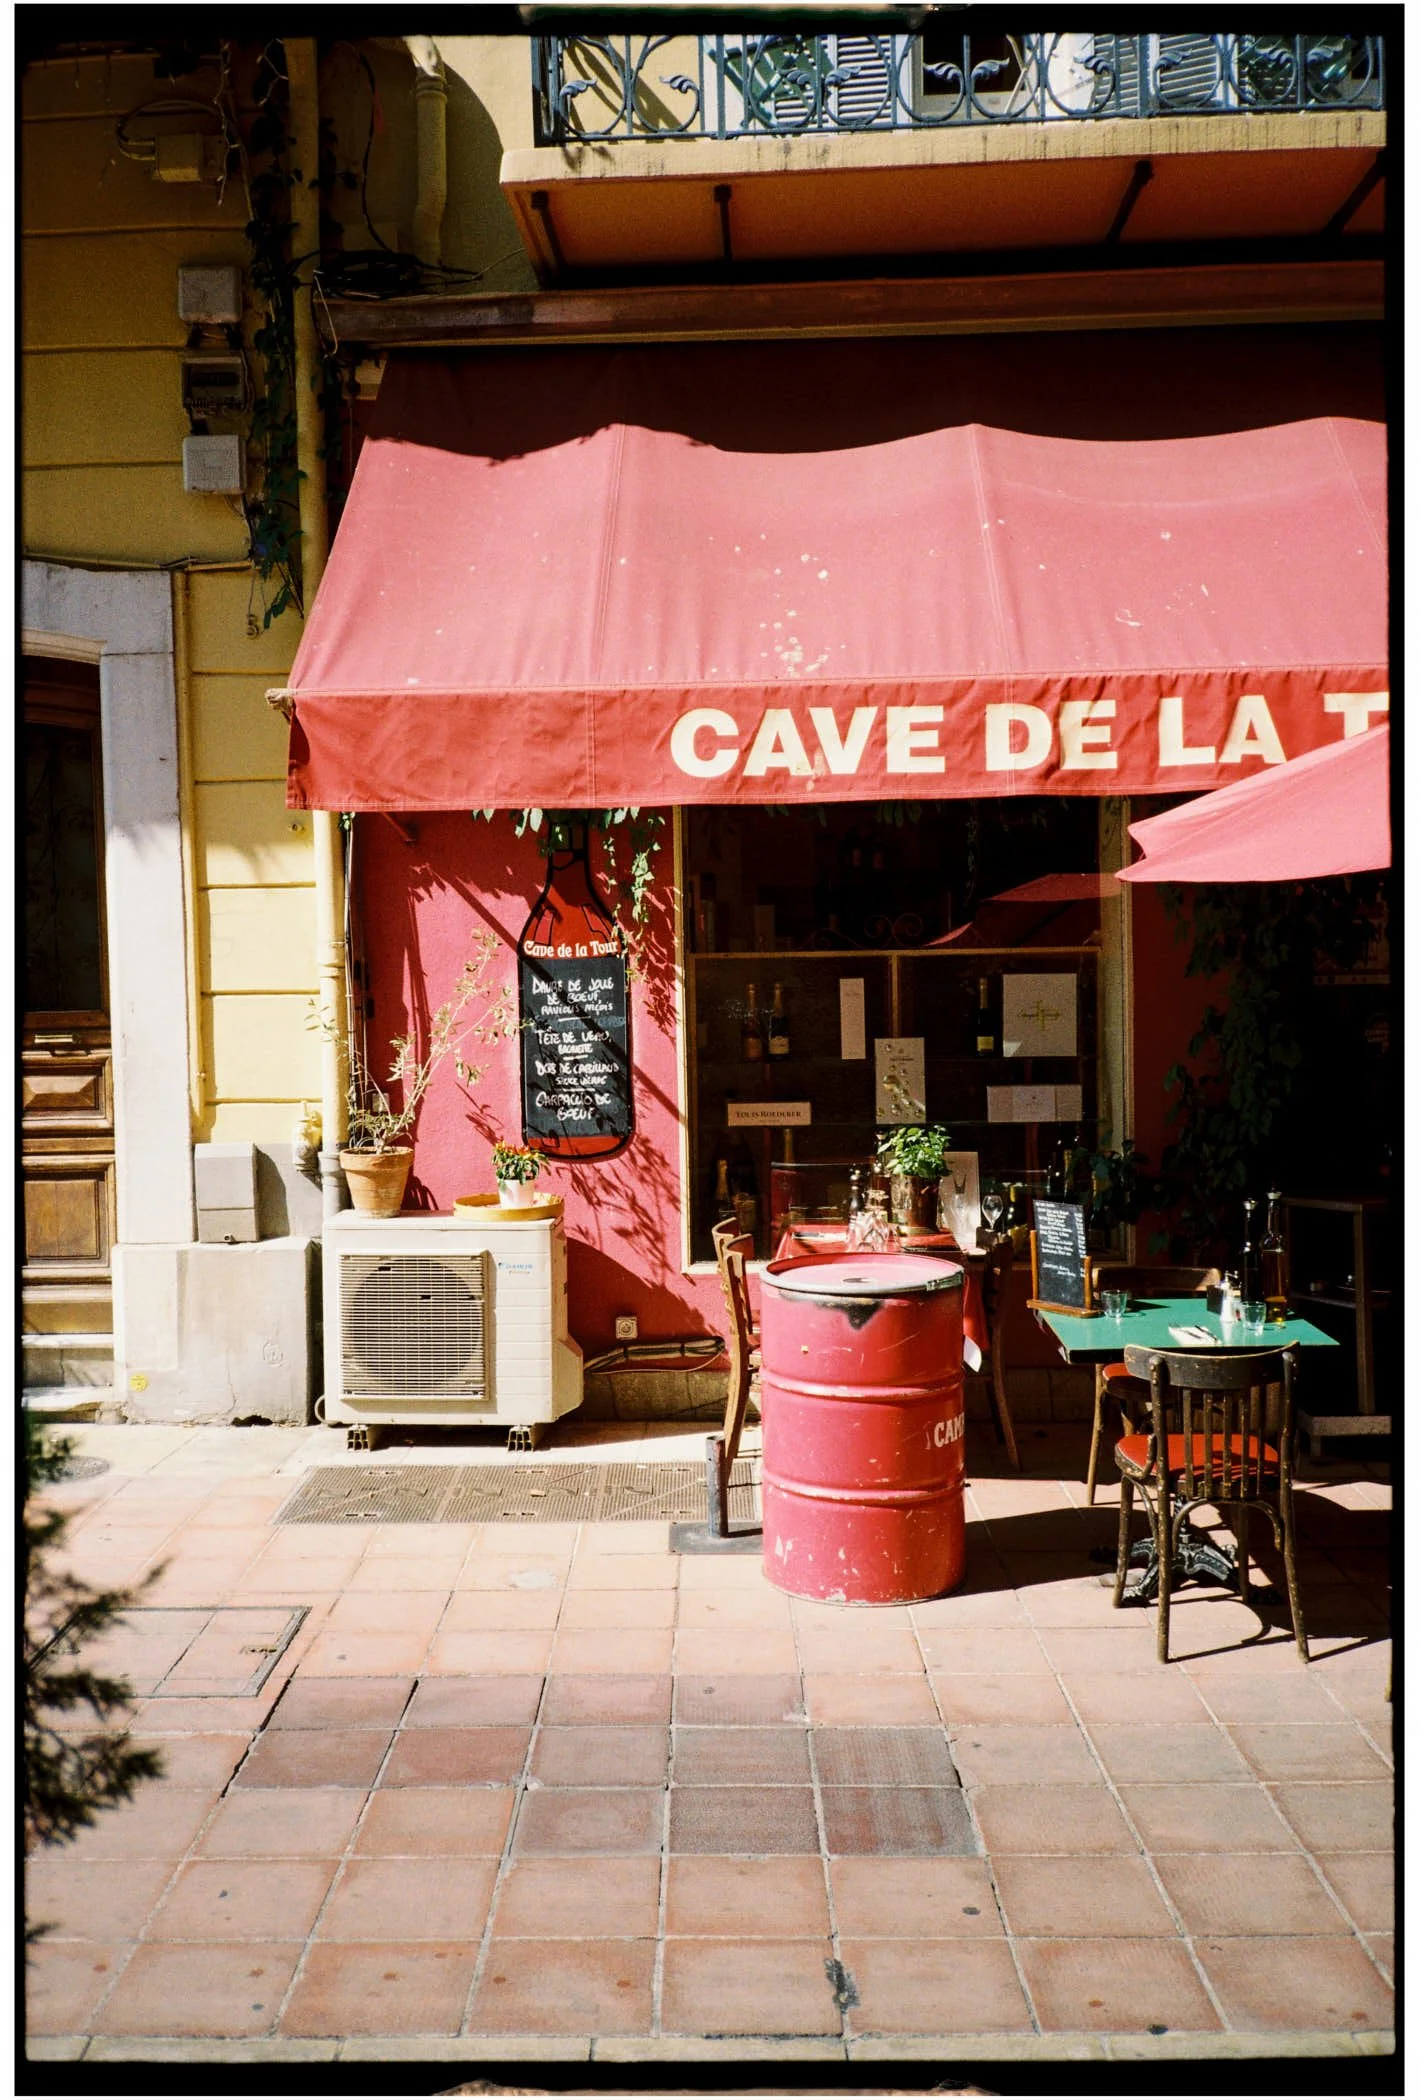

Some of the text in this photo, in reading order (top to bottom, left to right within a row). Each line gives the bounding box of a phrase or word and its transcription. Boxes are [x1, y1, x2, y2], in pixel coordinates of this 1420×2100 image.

[670, 706, 945, 777] CAVE
[985, 700, 1118, 771] DE
[1158, 695, 1287, 766] LA
[524, 940, 618, 957] Cave de la Tour
[568, 980, 581, 992] DE
[588, 977, 614, 991] JOUE
[547, 992, 565, 1005] DE
[562, 1031, 576, 1043] DE
[560, 1062, 572, 1074] DE
